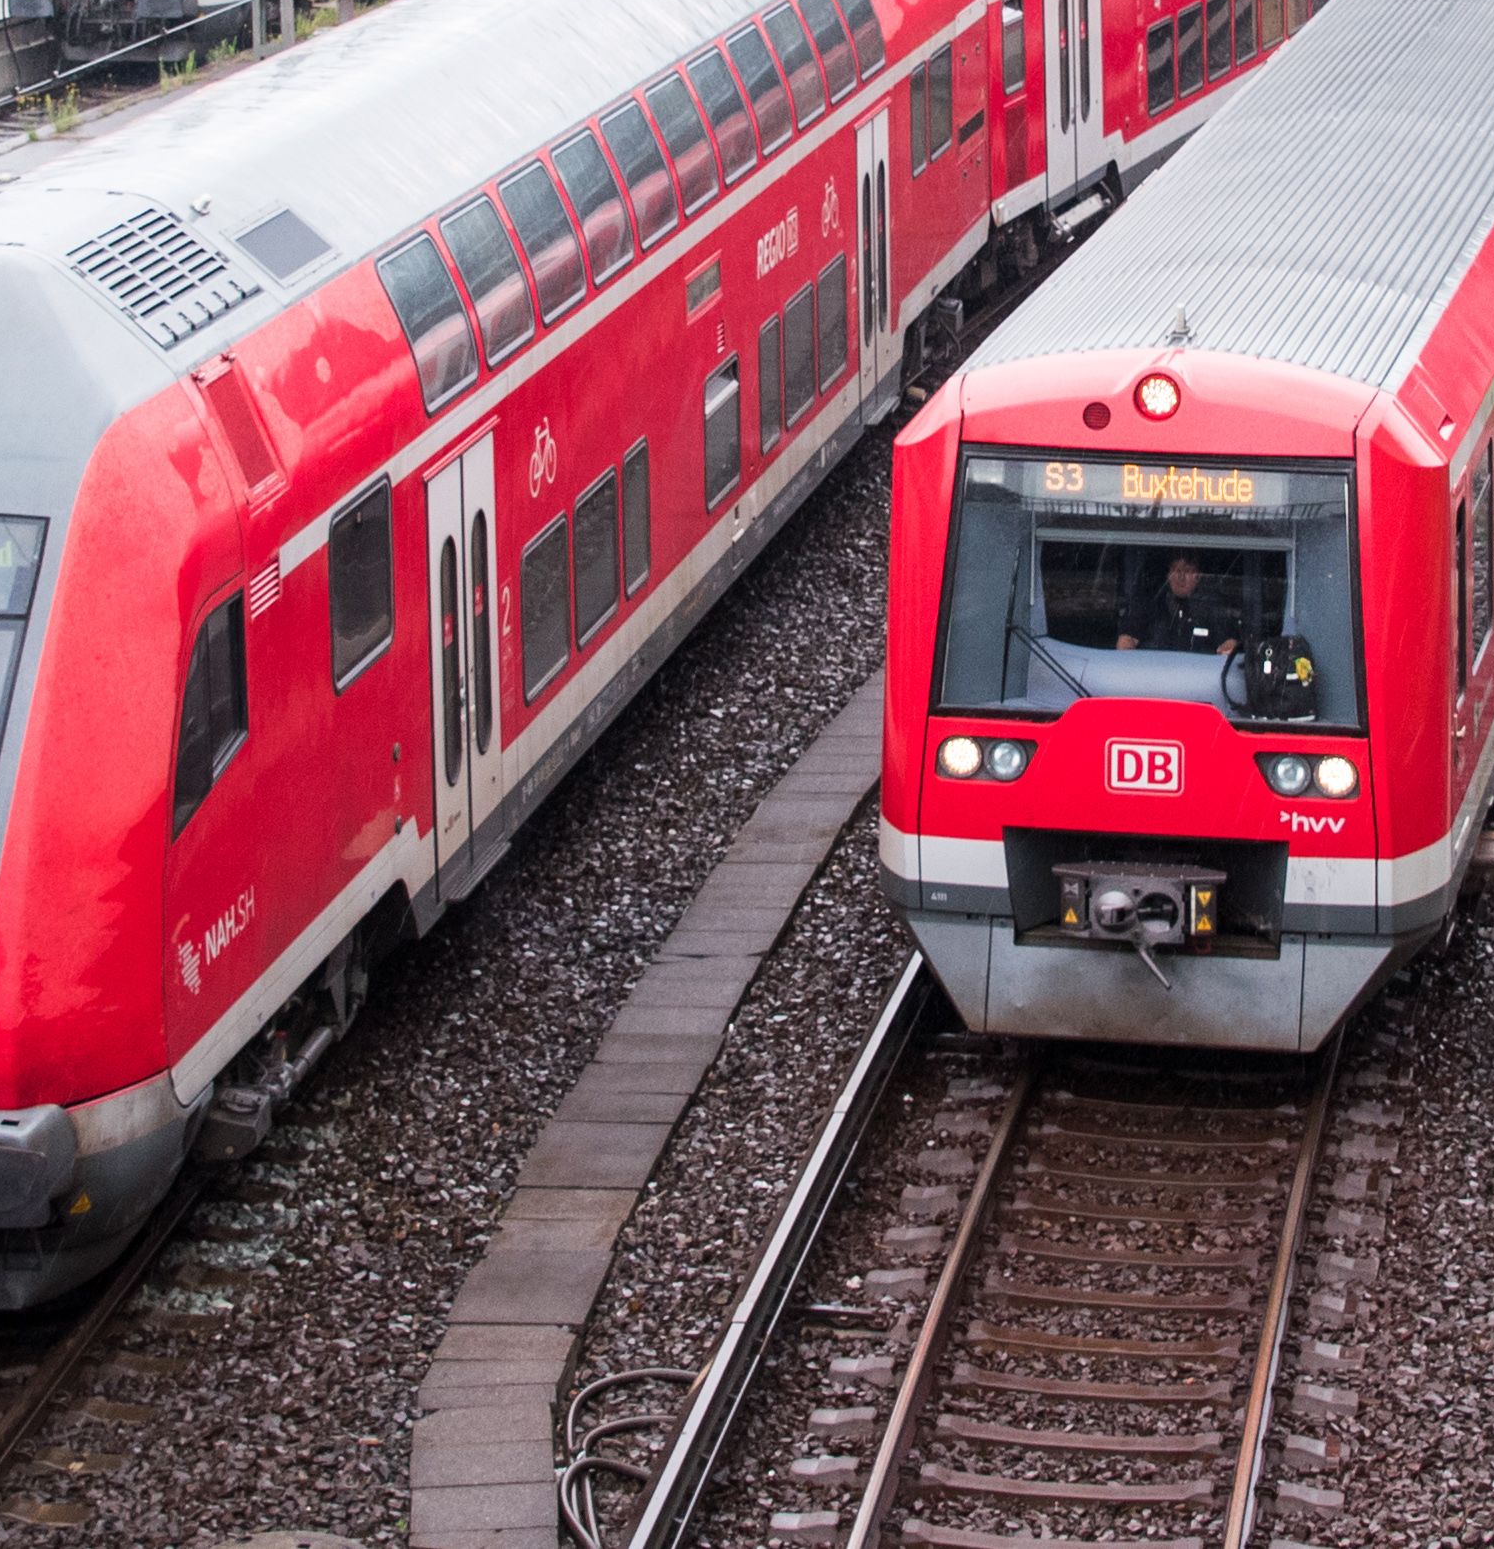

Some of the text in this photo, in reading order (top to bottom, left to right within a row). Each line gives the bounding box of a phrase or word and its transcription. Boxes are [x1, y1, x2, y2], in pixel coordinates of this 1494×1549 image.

[757, 220, 785, 281] REGIO
[1045, 461, 1253, 503] S3 Buxtehude
[502, 585, 511, 637] 2
[1117, 749, 1174, 785] DB
[205, 885, 255, 966] NAH.SH
